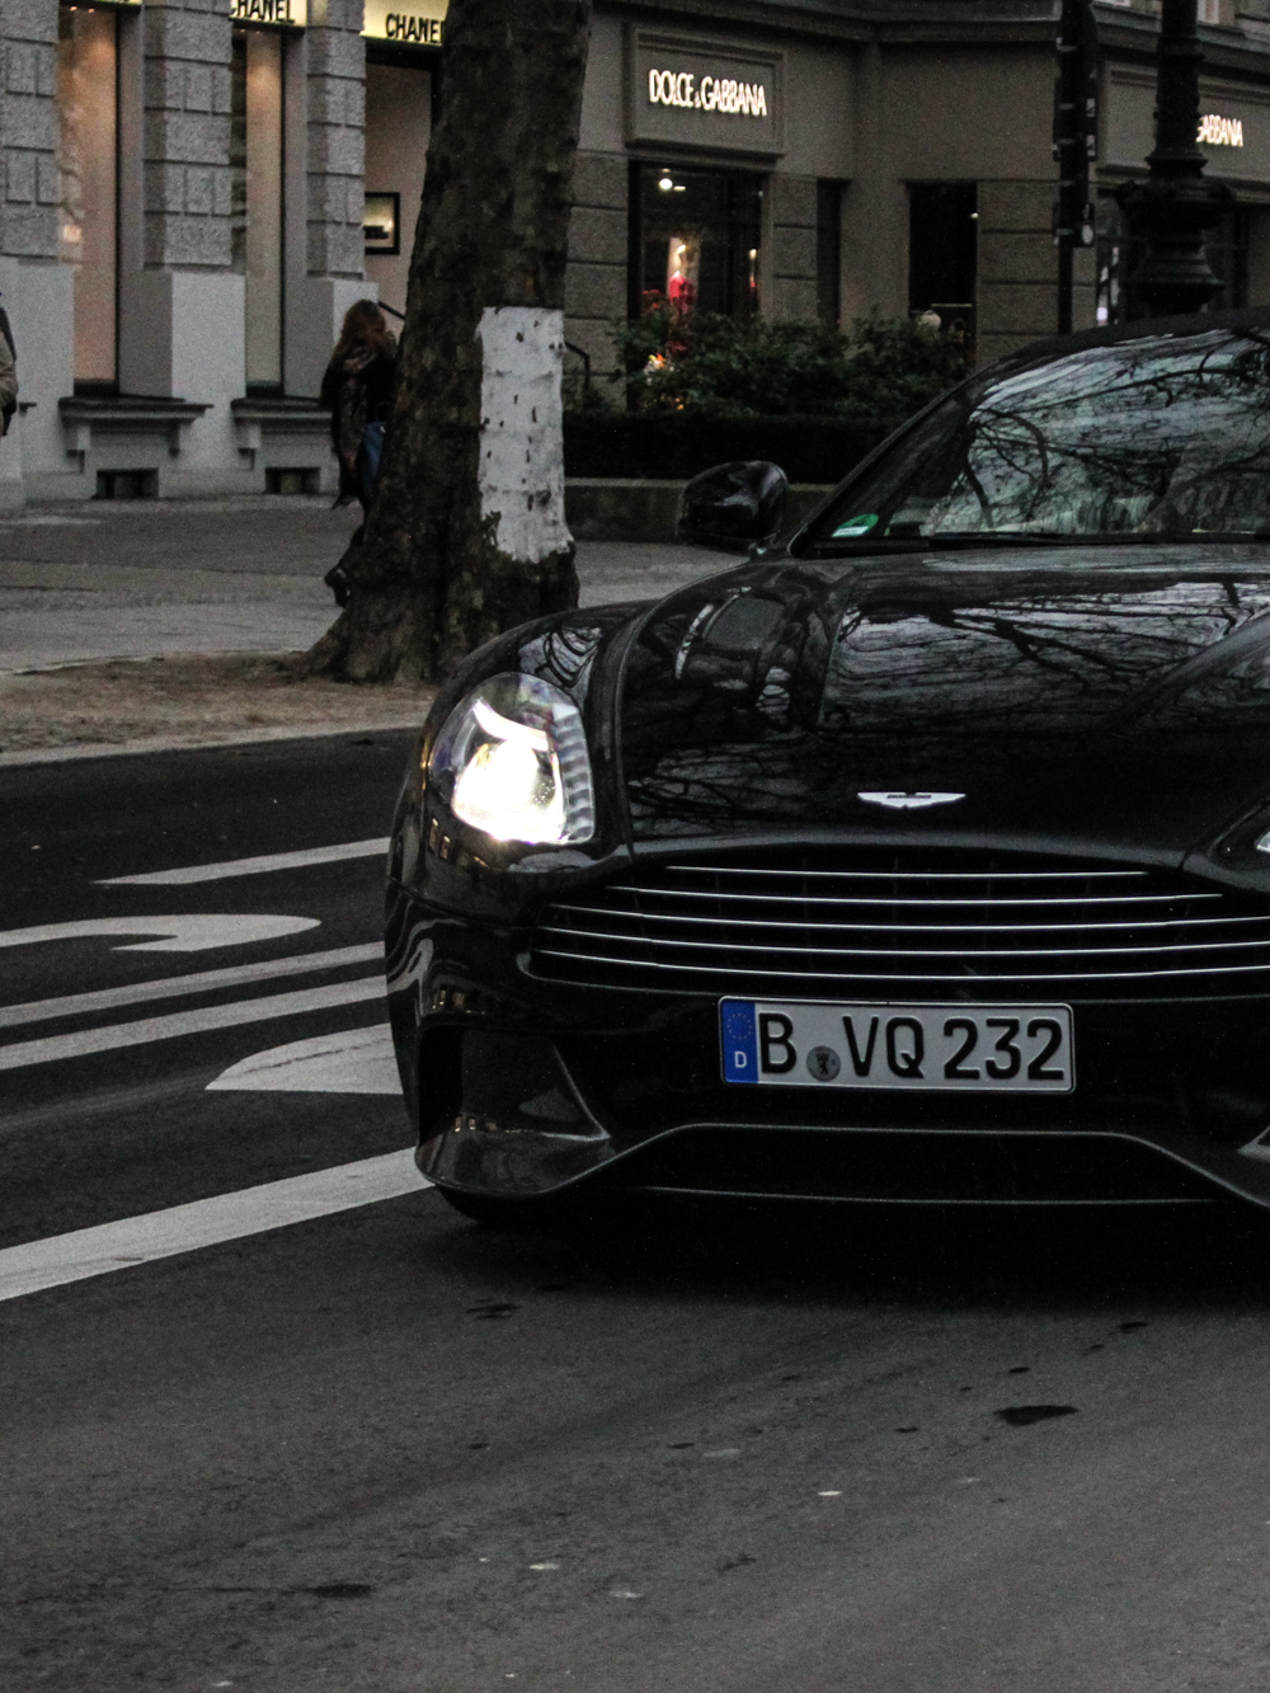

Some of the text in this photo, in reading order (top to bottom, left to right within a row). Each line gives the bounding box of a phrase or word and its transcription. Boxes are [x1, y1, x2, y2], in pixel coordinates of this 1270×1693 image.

[230, 0, 295, 24] HANEL
[758, 1012, 1065, 1082] B VQ 232
[735, 1050, 747, 1069] D
